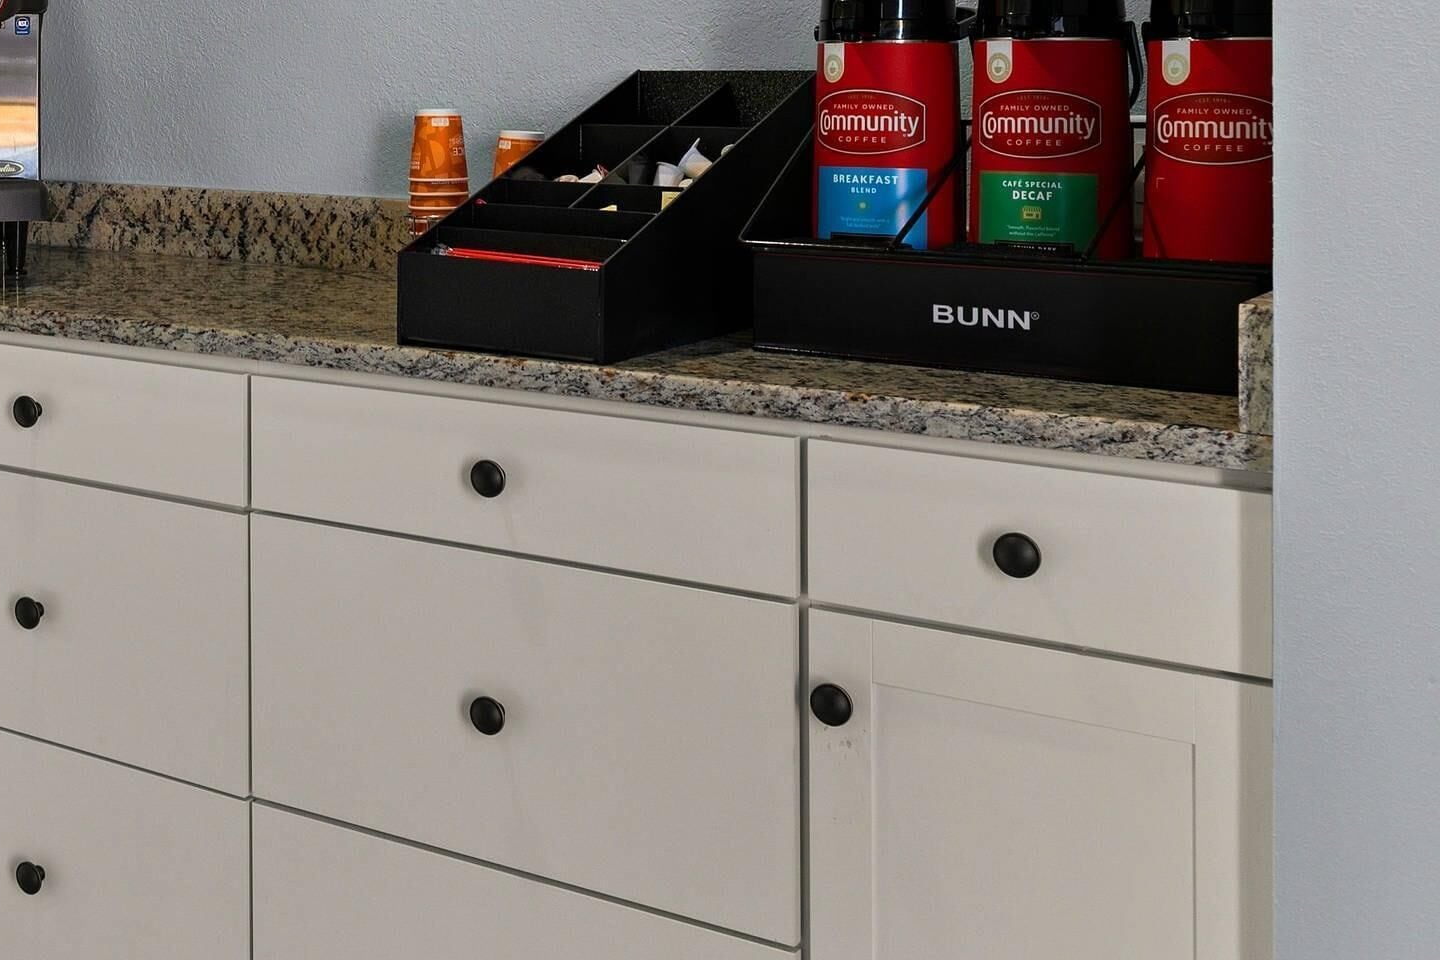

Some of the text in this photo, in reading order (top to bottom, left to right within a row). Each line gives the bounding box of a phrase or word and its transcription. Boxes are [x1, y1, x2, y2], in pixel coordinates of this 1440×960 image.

[1000, 104, 1070, 112] FAMILY OWNED
[1176, 107, 1253, 116] FAMILY OWNED
[820, 109, 919, 137] Community
[982, 111, 1096, 140] Community
[838, 135, 887, 144] COFFEE
[1006, 138, 1063, 147] COFFEE
[1183, 143, 1244, 153] COFFEE
[832, 174, 899, 185] BREAKFAST
[1002, 179, 1063, 189] CAFÉ SPECIAL
[850, 186, 877, 194] BLEND
[1012, 190, 1054, 201] DECAF
[932, 303, 1031, 331] BUNN
